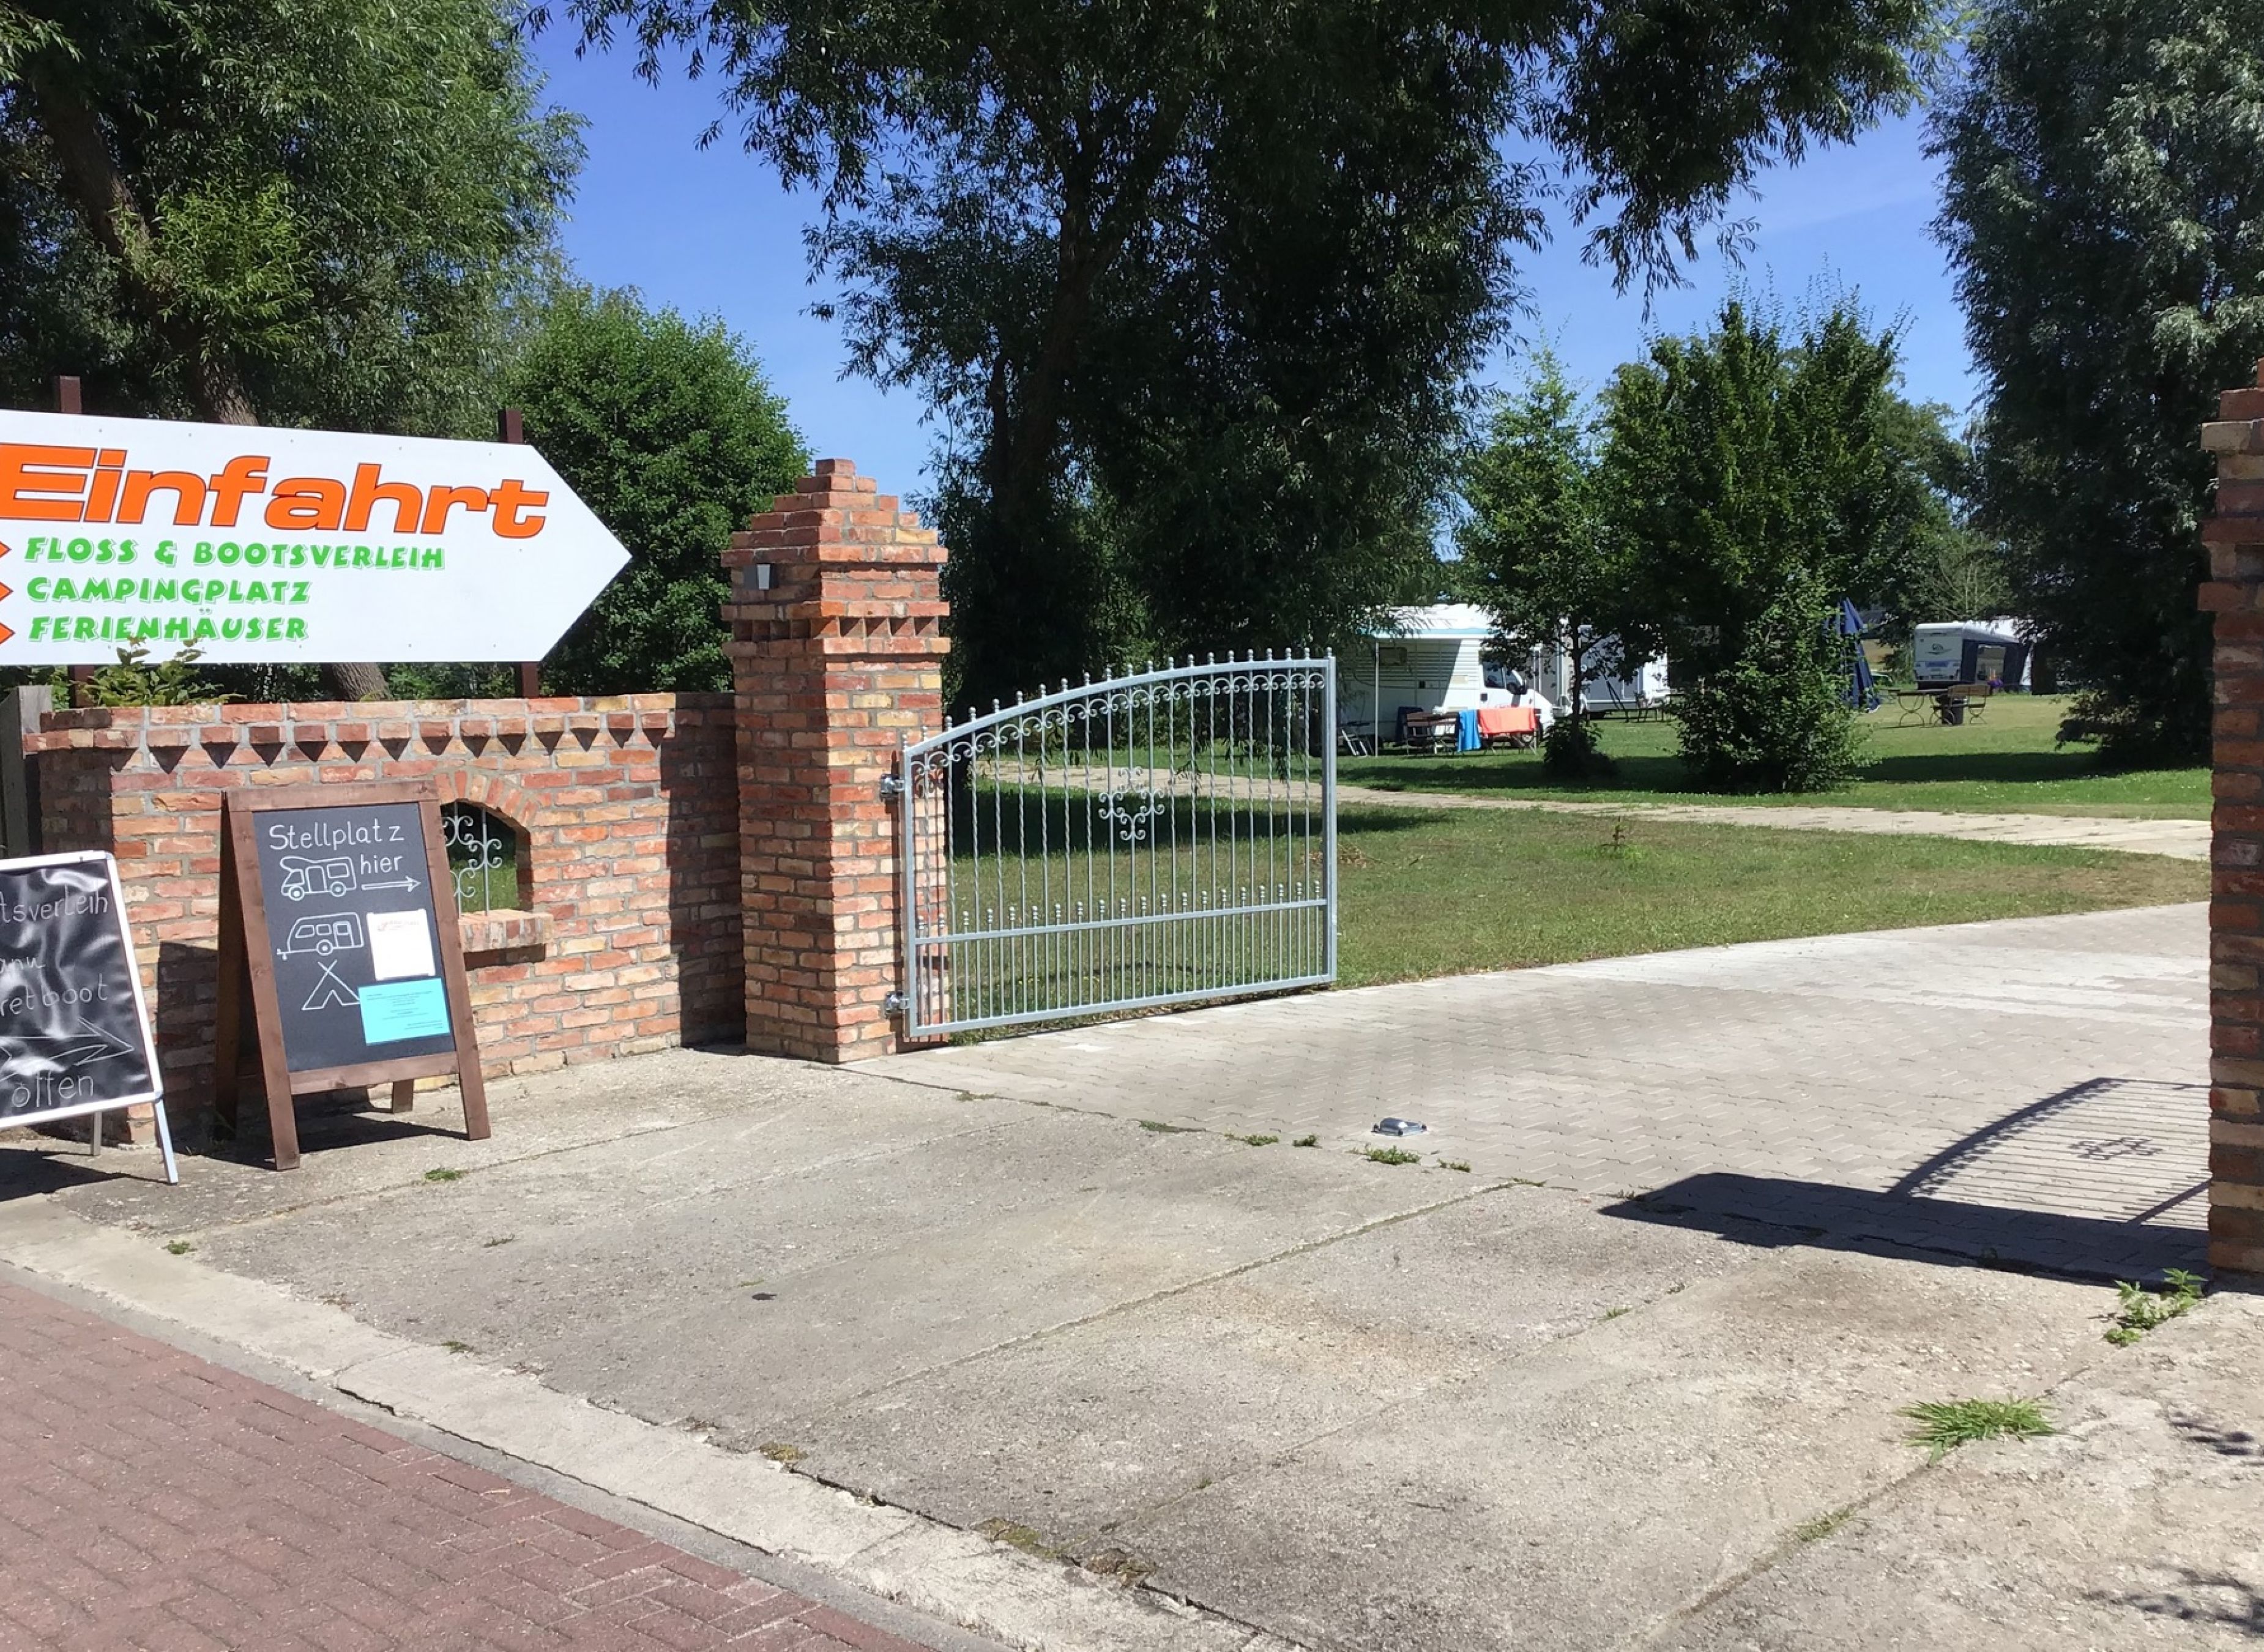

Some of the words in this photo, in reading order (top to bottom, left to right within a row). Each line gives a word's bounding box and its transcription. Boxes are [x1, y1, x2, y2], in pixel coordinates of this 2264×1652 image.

[0, 442, 549, 538] Einfahrt
[25, 537, 136, 565] FLOSS
[154, 540, 176, 567] &
[193, 541, 445, 570] BOOTSVERLEIH
[26, 576, 311, 604] CAMPINGPLATZ
[29, 608, 307, 642] FERIENHÄUSER
[269, 818, 404, 850] Stellplatz
[360, 854, 403, 875] hier
[12, 1070, 94, 1107] offen
